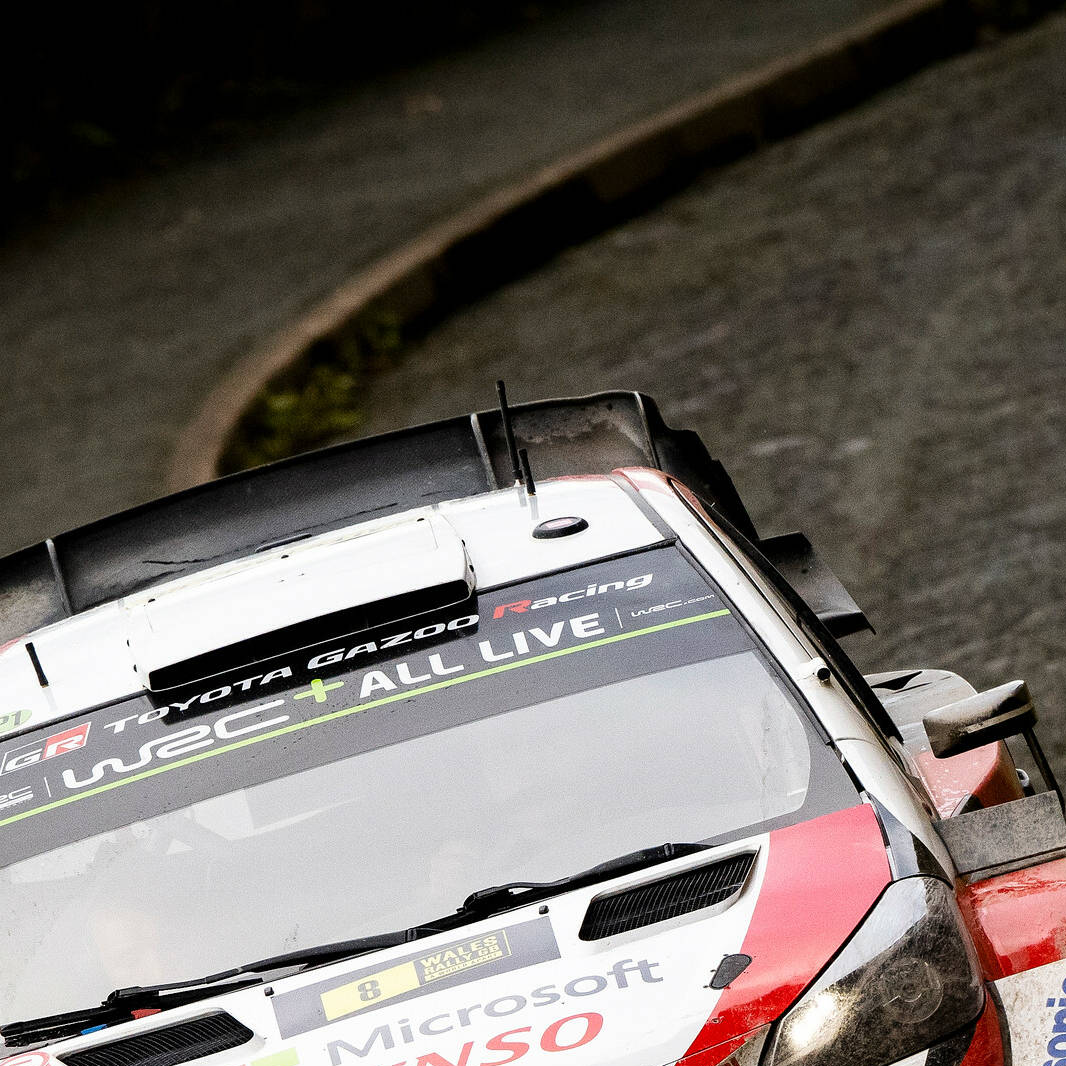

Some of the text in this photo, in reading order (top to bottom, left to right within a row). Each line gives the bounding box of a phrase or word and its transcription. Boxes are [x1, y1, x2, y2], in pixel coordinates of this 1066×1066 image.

[5, 573, 653, 772] GR TOYOTA GAZOO Racing
[359, 653, 465, 699] ALL
[479, 613, 605, 662] LIVE
[420, 935, 498, 968] WALES
[424, 944, 501, 975] RALLY GB
[326, 958, 664, 1066] Microsoft
[357, 979, 382, 1001] 8
